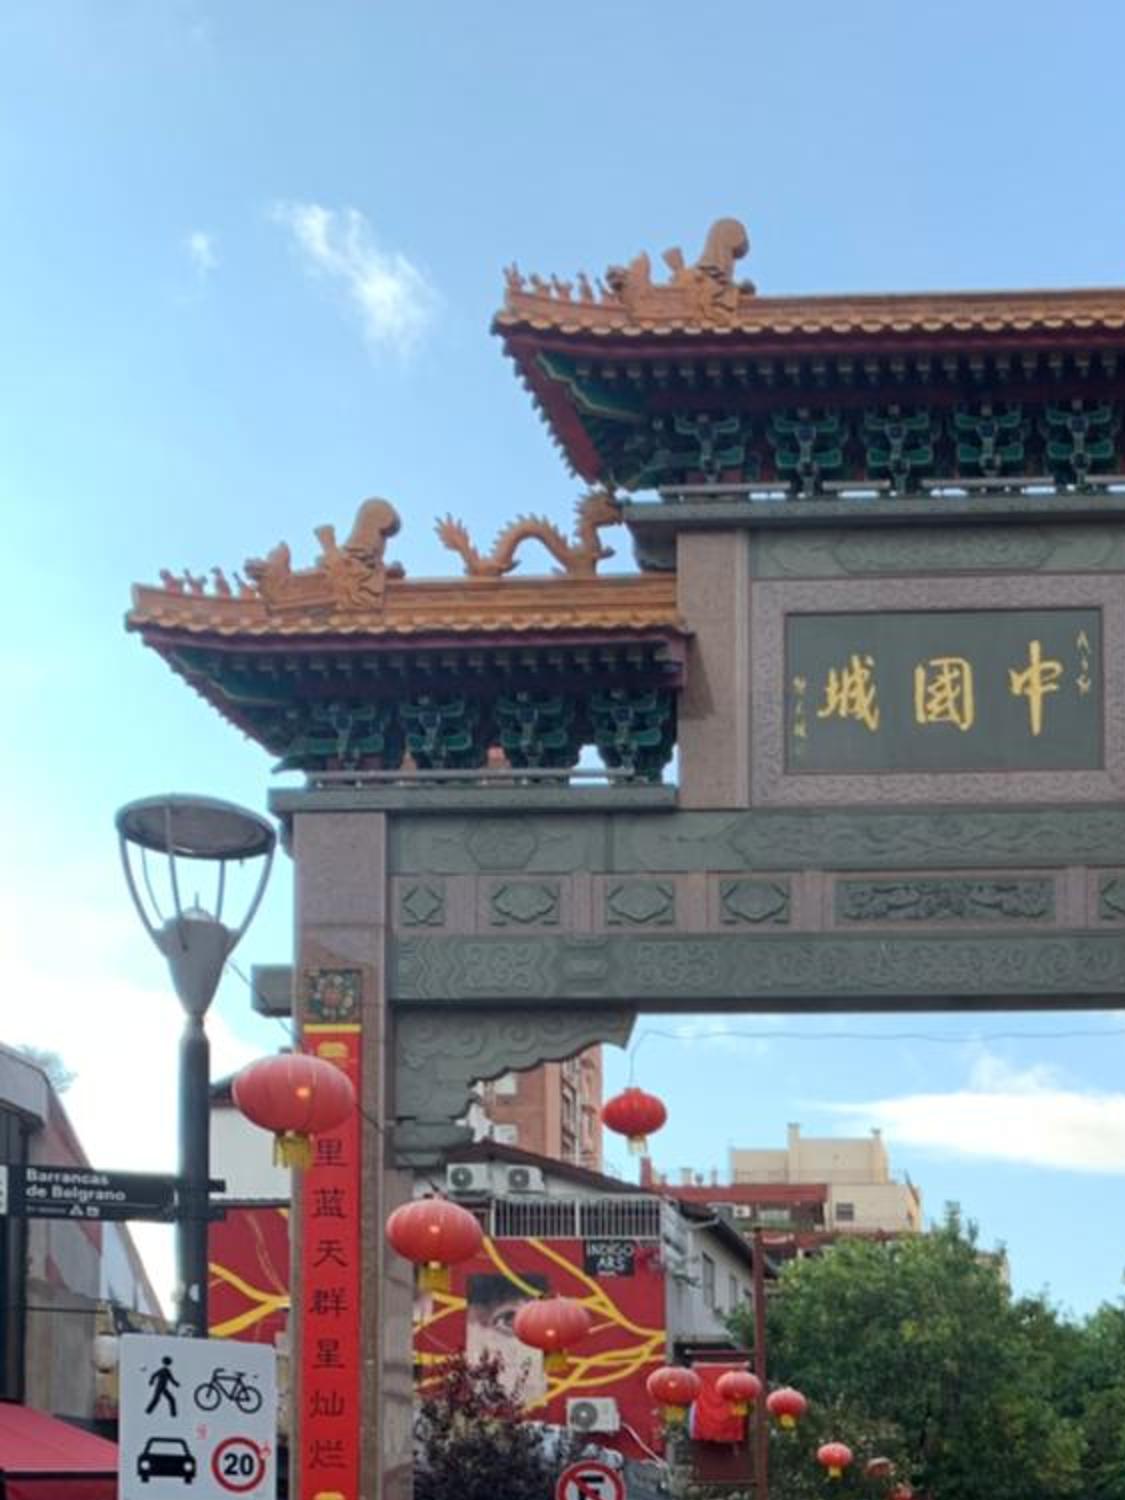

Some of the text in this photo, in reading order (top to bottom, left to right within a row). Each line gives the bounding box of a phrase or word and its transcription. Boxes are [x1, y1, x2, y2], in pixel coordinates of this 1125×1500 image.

[26, 1167, 109, 1185] Barrancas
[25, 1185, 126, 1202] de Belgrano
[309, 1138, 348, 1470] 里蓝天群星灿烂
[223, 1453, 254, 1477] 20
